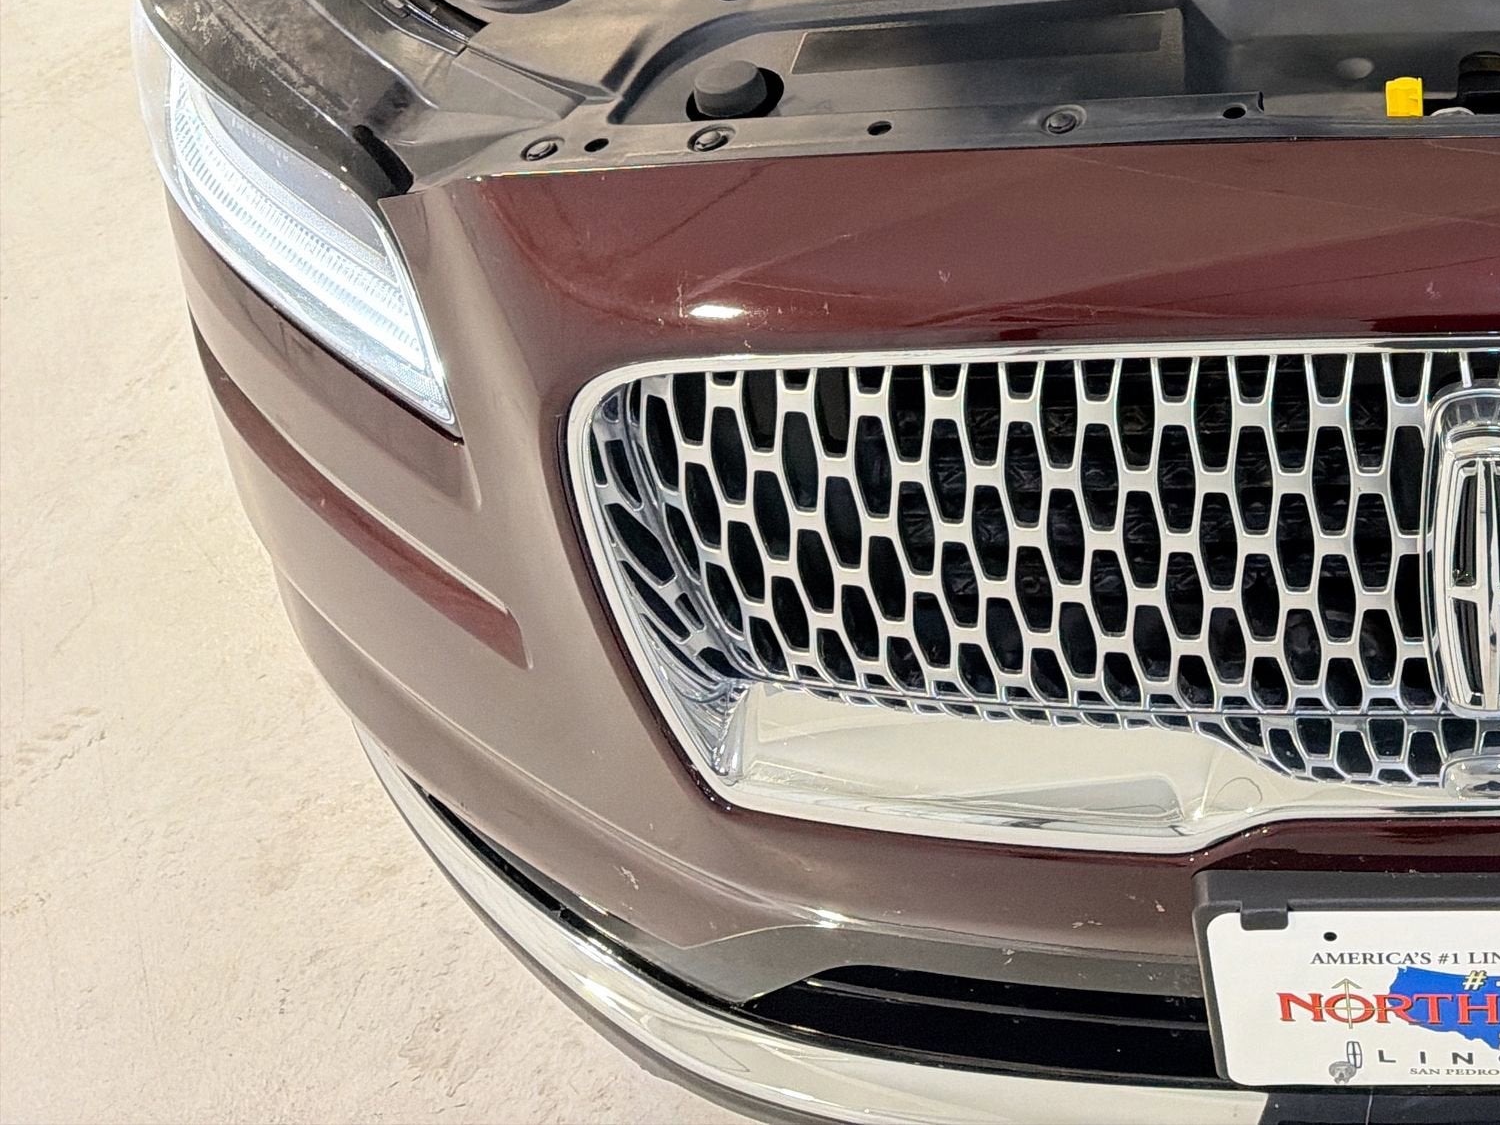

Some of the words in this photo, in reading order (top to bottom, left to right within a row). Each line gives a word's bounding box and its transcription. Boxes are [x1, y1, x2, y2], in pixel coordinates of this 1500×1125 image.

[1310, 951, 1431, 966] AMERICA’S
[1438, 952, 1460, 965] #1
[1276, 992, 1500, 1025] NORTH
[1410, 1068, 1441, 1076] SAN
[1445, 1068, 1500, 1076] PEDRO
